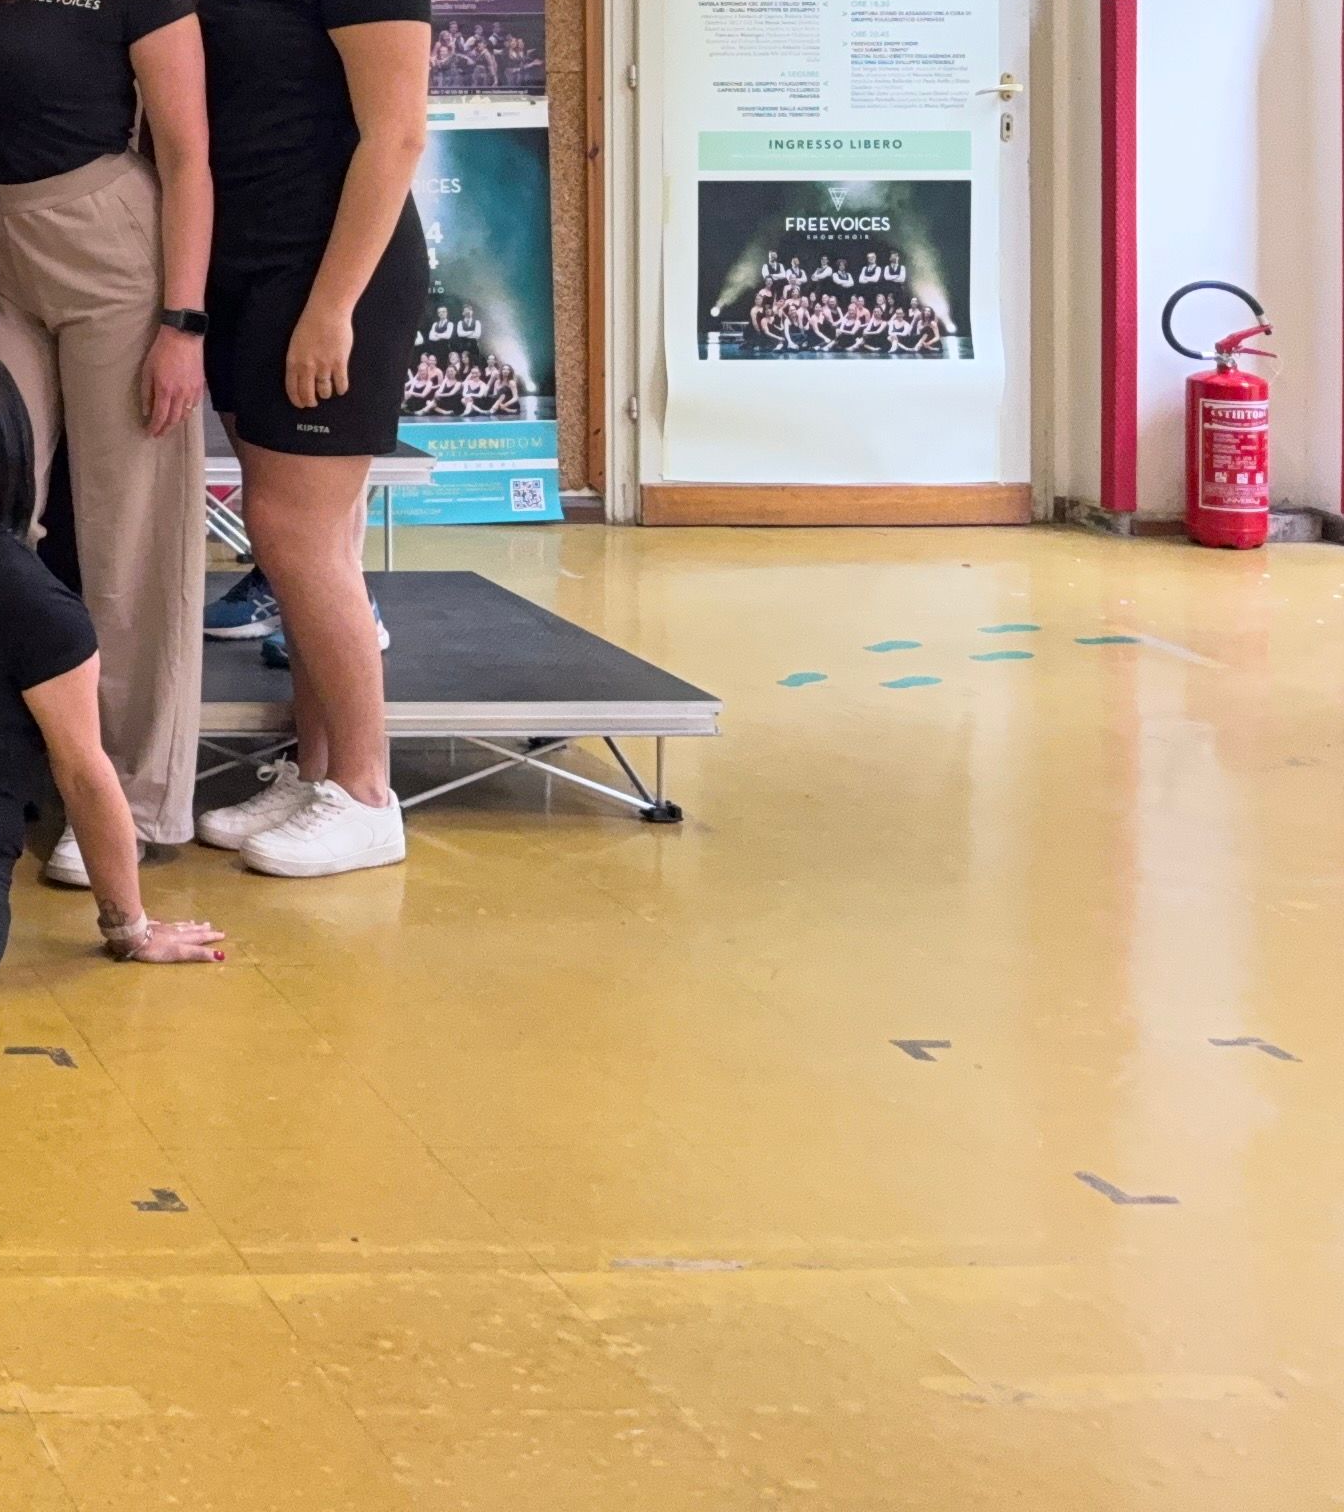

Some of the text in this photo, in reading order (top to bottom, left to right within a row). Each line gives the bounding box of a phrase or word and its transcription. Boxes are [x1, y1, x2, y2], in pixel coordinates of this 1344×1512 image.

[768, 139, 903, 150] INGRESSO LIBERO
[785, 216, 891, 232] FREEVOICES
[296, 423, 330, 434] KIPSTA
